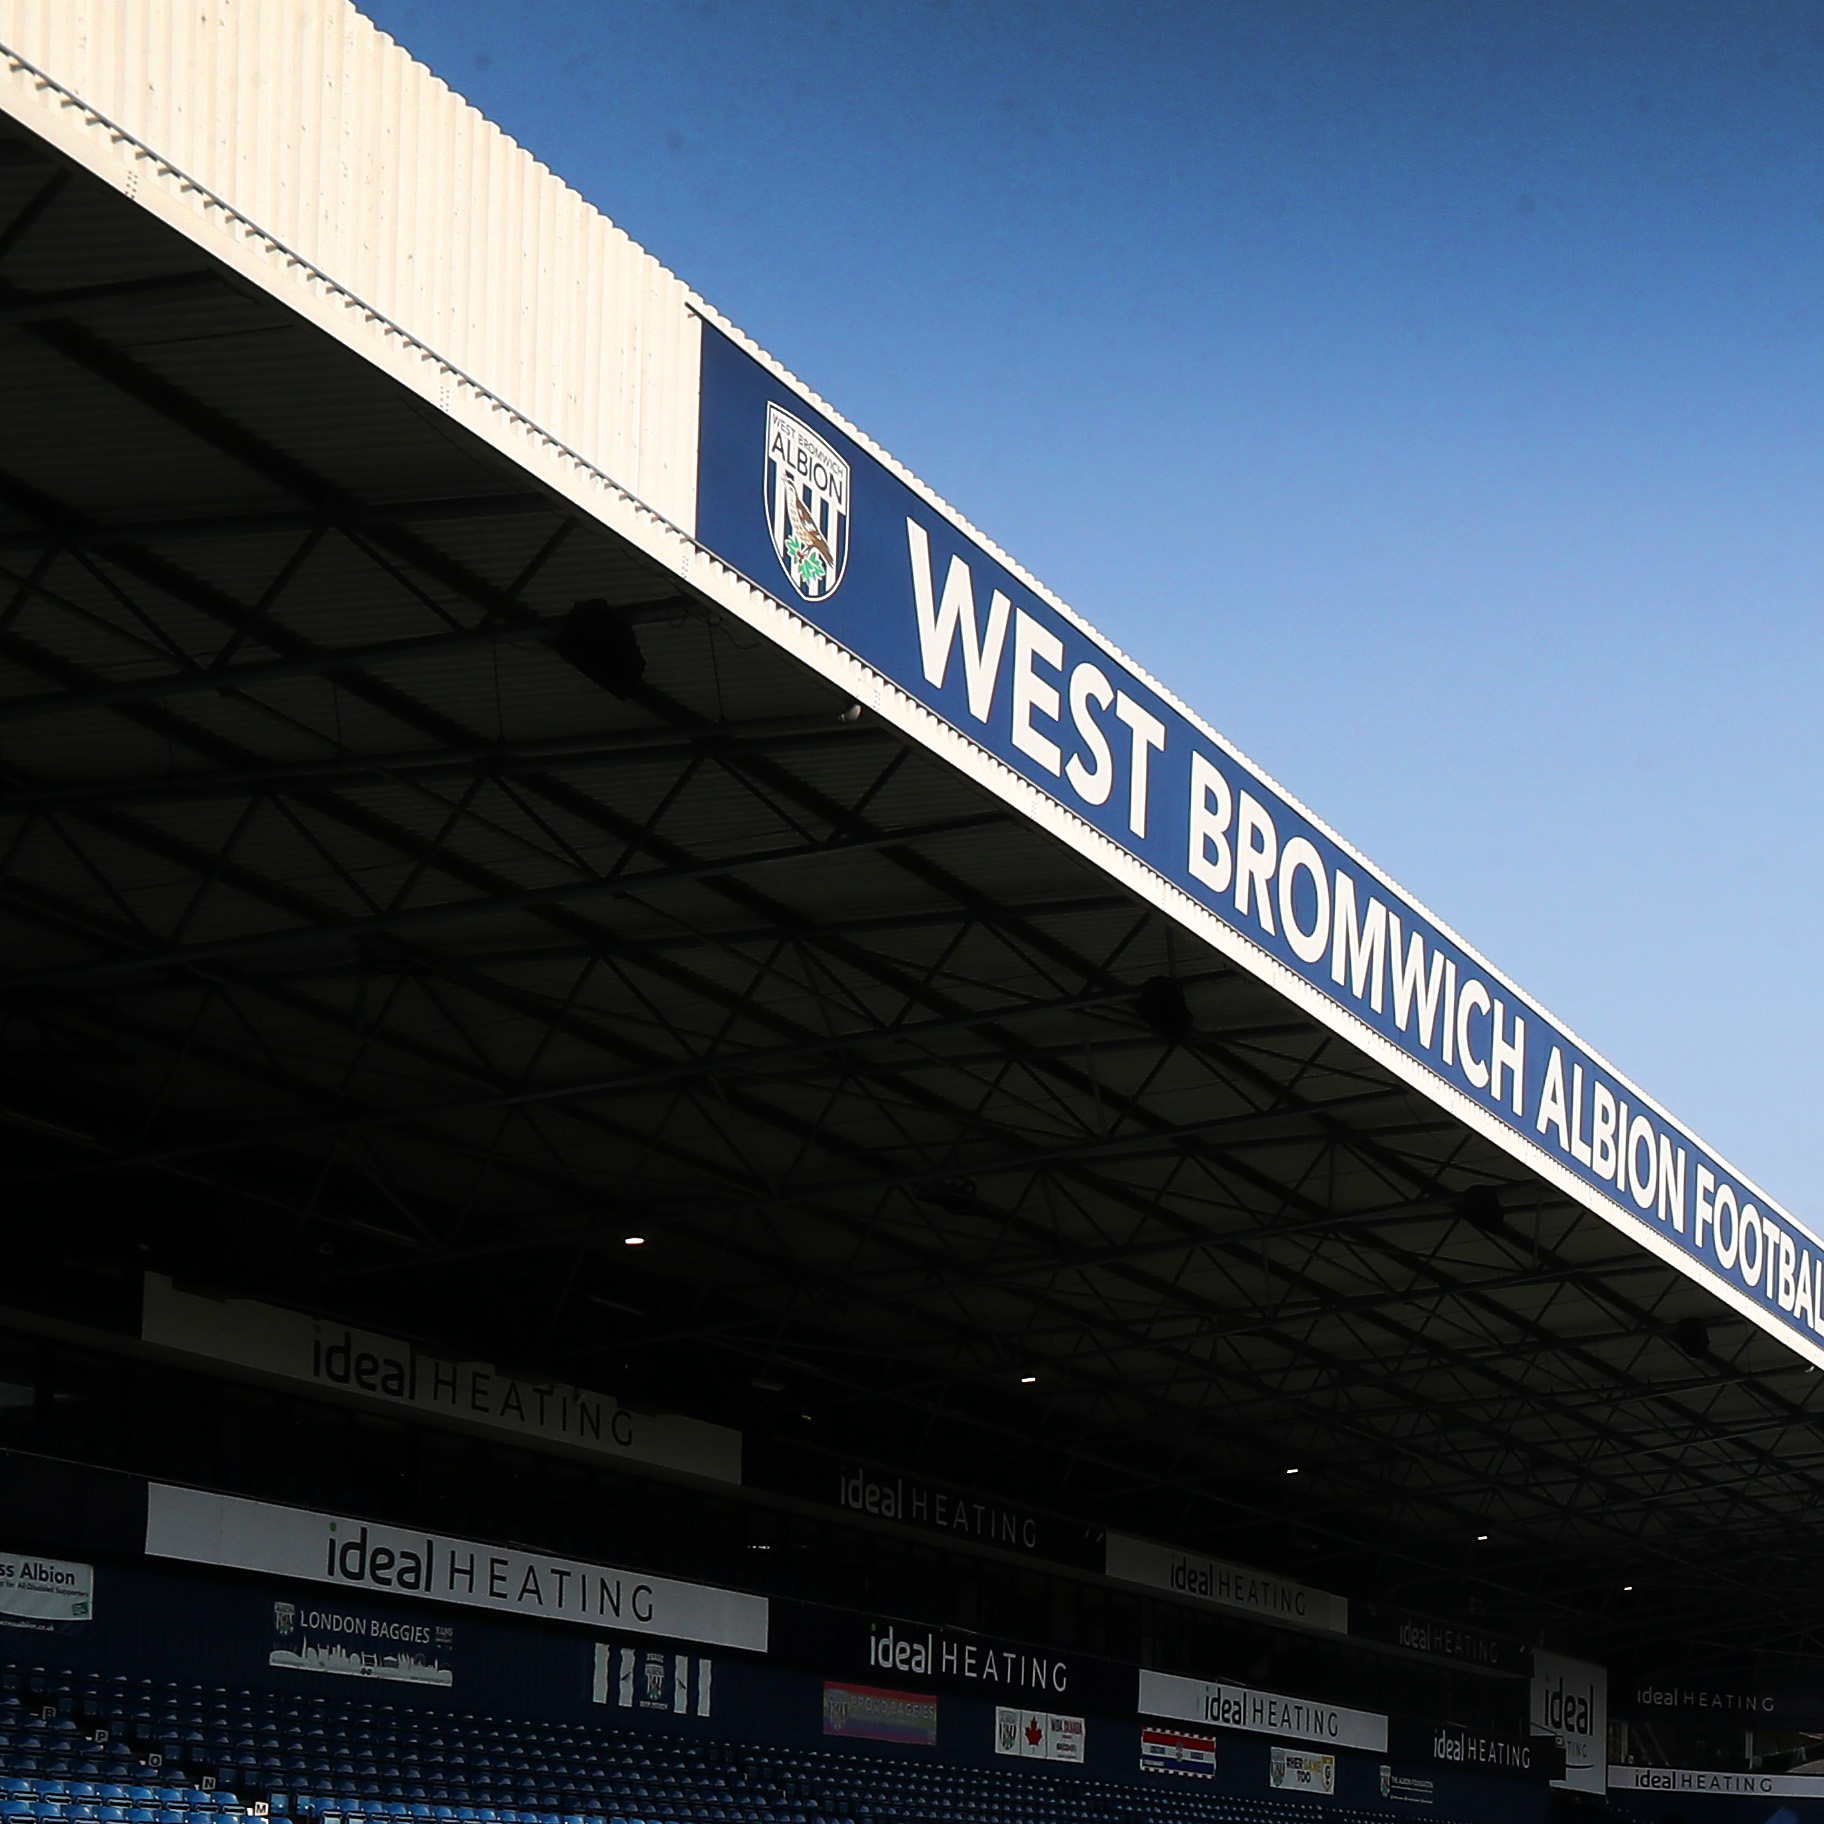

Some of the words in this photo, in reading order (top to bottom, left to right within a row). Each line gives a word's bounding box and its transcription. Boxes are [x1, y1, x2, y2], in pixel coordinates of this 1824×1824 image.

[771, 432, 843, 505] ALBION
[773, 413, 795, 438] WEST
[798, 432, 844, 478] BROMWICH
[906, 516, 1166, 840] WEST
[1188, 749, 1526, 1117] BROMWICH
[1536, 1044, 1687, 1234] ALBION
[313, 1323, 416, 1400] ideal
[433, 1362, 633, 1446] HEATING
[840, 1465, 903, 1520] ideal
[912, 1488, 1037, 1549] HEATING
[21, 1563, 75, 1586] Albion
[327, 1522, 433, 1592] ideal
[449, 1550, 654, 1622] HEATING
[1170, 1556, 1213, 1596] ideal
[1219, 1571, 1305, 1616] HEATING
[300, 1609, 367, 1636] LONDON
[370, 1620, 431, 1644] BAGGIES
[1399, 1618, 1431, 1651] ideal
[1434, 1627, 1499, 1664] HEATING
[870, 1622, 932, 1675] ideal
[942, 1640, 1067, 1692] HEATING
[851, 1696, 888, 1714] PROUD
[891, 1701, 934, 1719] BAGGIES
[1205, 1686, 1247, 1725] ideal
[1253, 1698, 1339, 1738] HEATING
[1544, 1674, 1594, 1736] ideal
[1637, 1684, 1678, 1706] ideal
[1683, 1690, 1775, 1712] HEATING
[1433, 1728, 1465, 1761] ideal
[1468, 1737, 1531, 1769] HEATING
[1635, 1769, 1676, 1789] ideal
[1682, 1774, 1773, 1792] HEATING
